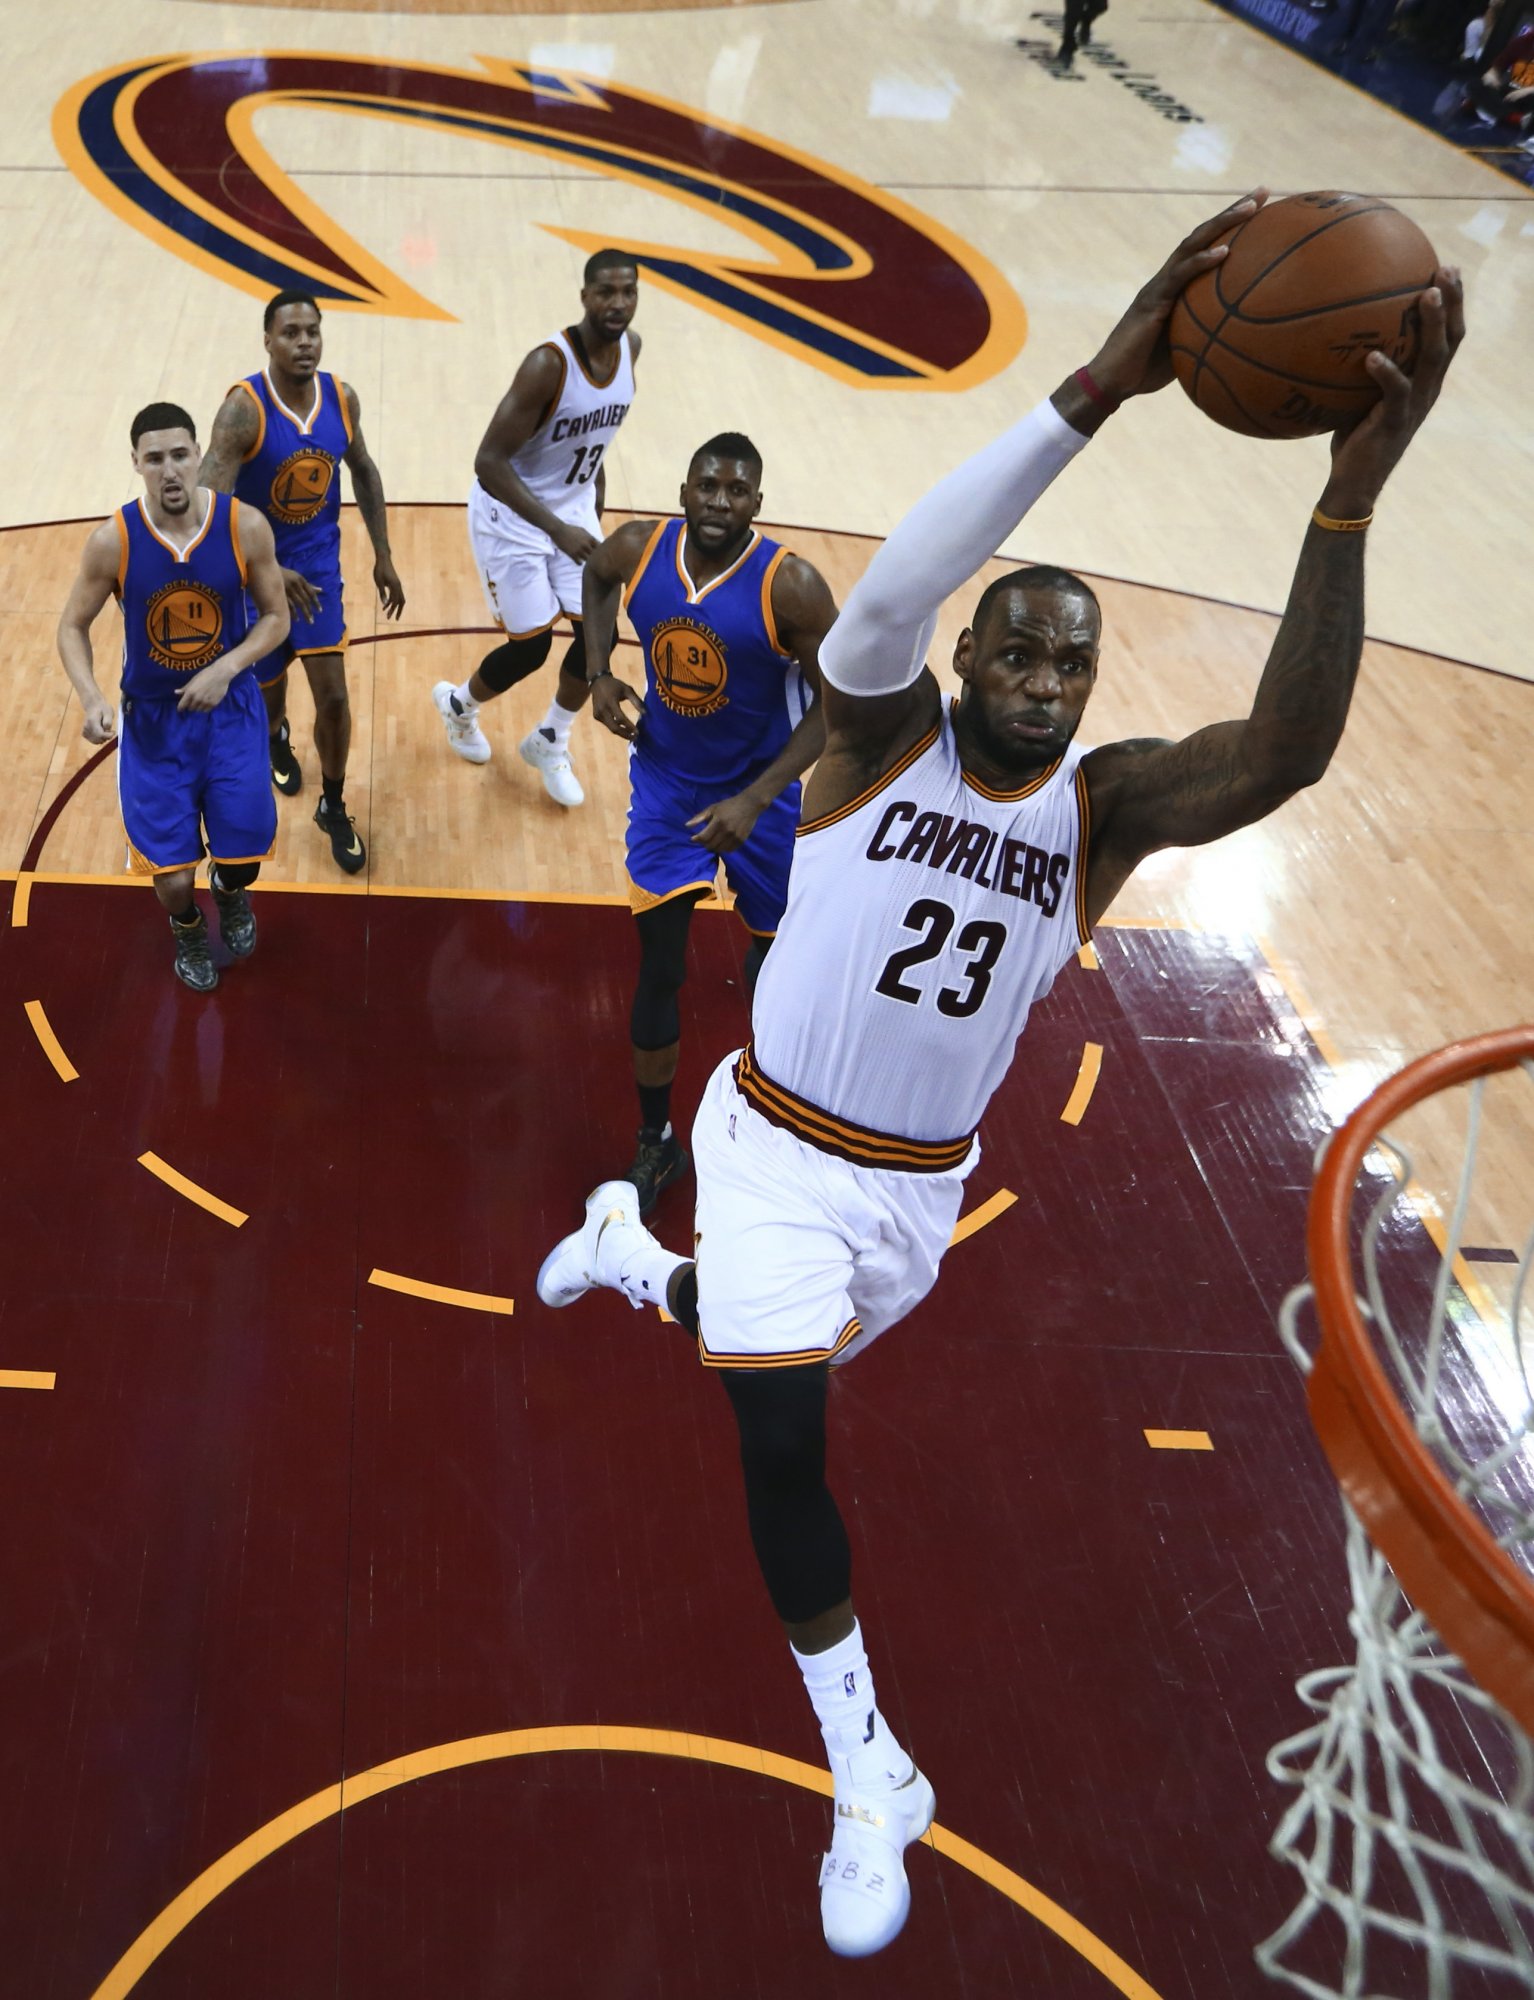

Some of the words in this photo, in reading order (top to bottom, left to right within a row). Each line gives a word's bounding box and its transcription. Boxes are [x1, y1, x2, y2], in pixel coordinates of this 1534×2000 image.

[565, 443, 604, 485] 13
[146, 579, 188, 606] GOLDEN
[193, 581, 223, 602] STATE
[189, 602, 202, 619] 11
[651, 616, 694, 636] GOLDEN
[698, 622, 729, 654] STATE
[148, 643, 224, 671] WARRIORS
[687, 646, 708, 668] 31
[655, 680, 730, 718] WARRIORS
[866, 801, 1070, 918] CAVALIERS
[872, 897, 1007, 1019] 23
